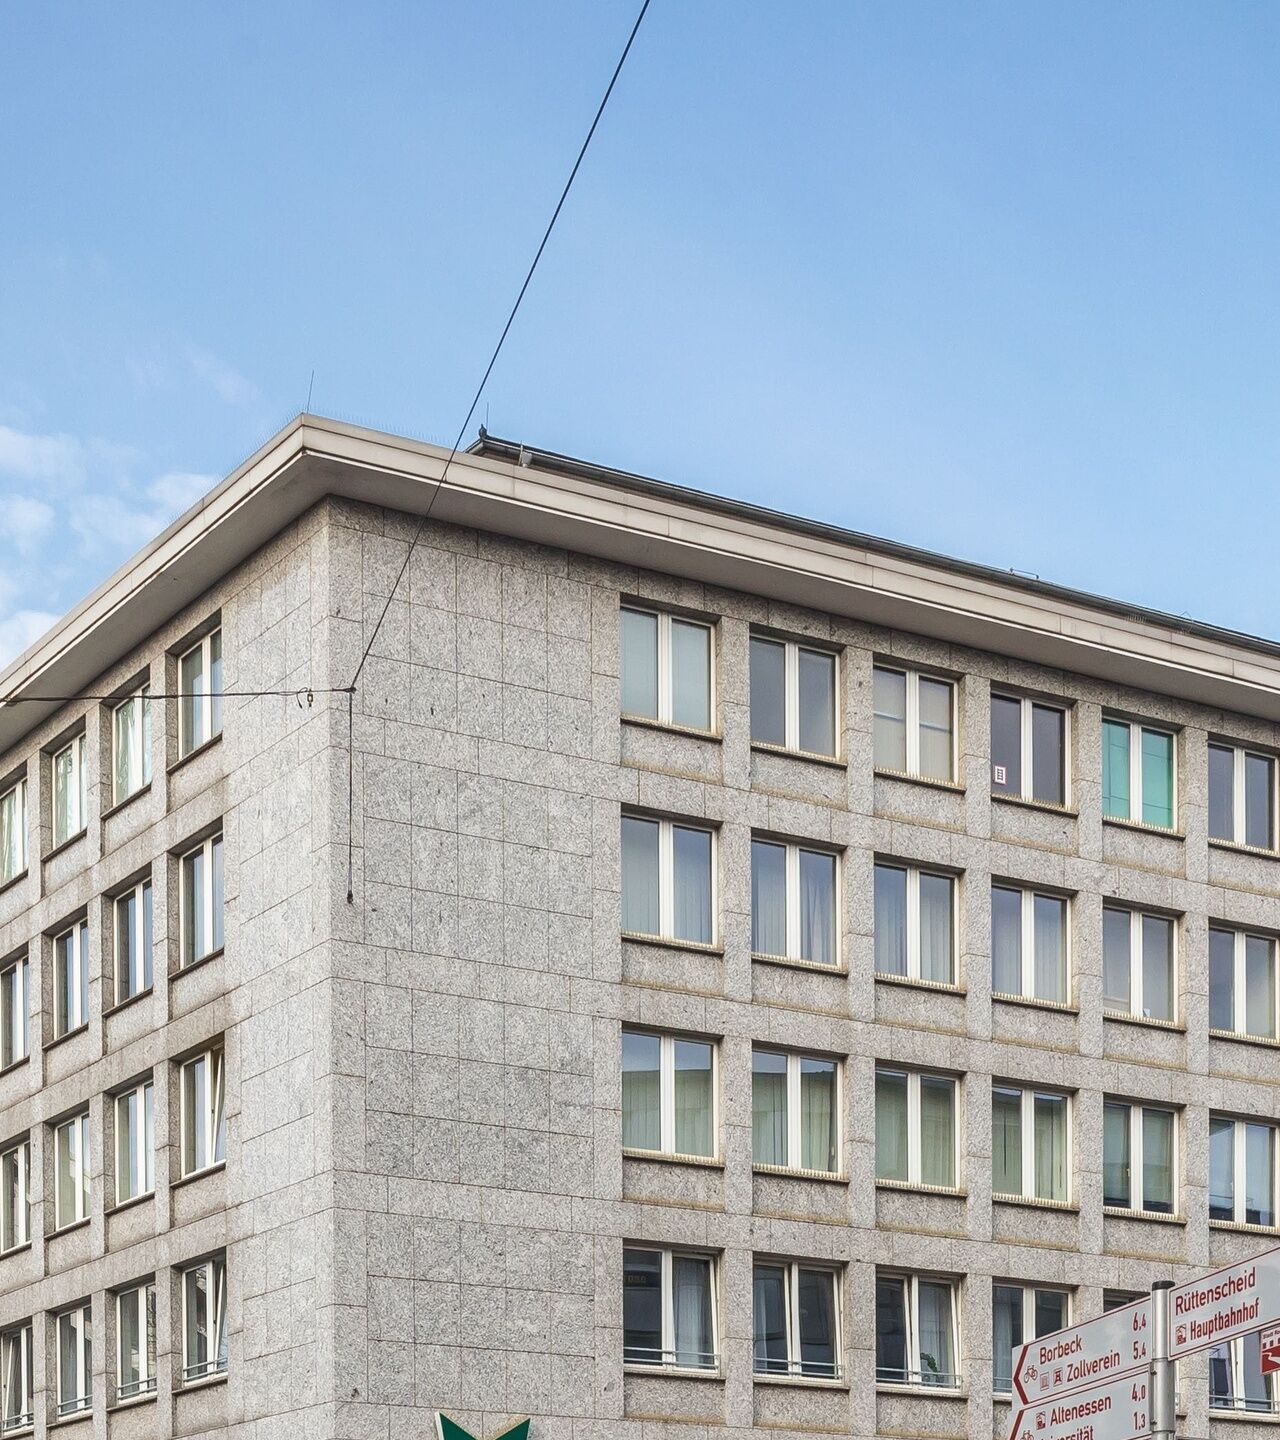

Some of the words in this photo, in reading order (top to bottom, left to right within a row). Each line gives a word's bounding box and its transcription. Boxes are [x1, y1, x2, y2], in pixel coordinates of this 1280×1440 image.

[1176, 1267, 1256, 1315] Rüttenscheid
[1040, 1334, 1082, 1364] Borbeck
[1132, 1312, 1146, 1331] 6,4
[1190, 1297, 1259, 1341] Hauptbahnhof
[1066, 1350, 1120, 1382] Zollverein
[1133, 1341, 1146, 1360] 5,4
[1050, 1396, 1112, 1426] Altenessen
[1131, 1383, 1146, 1403] 4,0
[1133, 1411, 1146, 1430] 1,3
